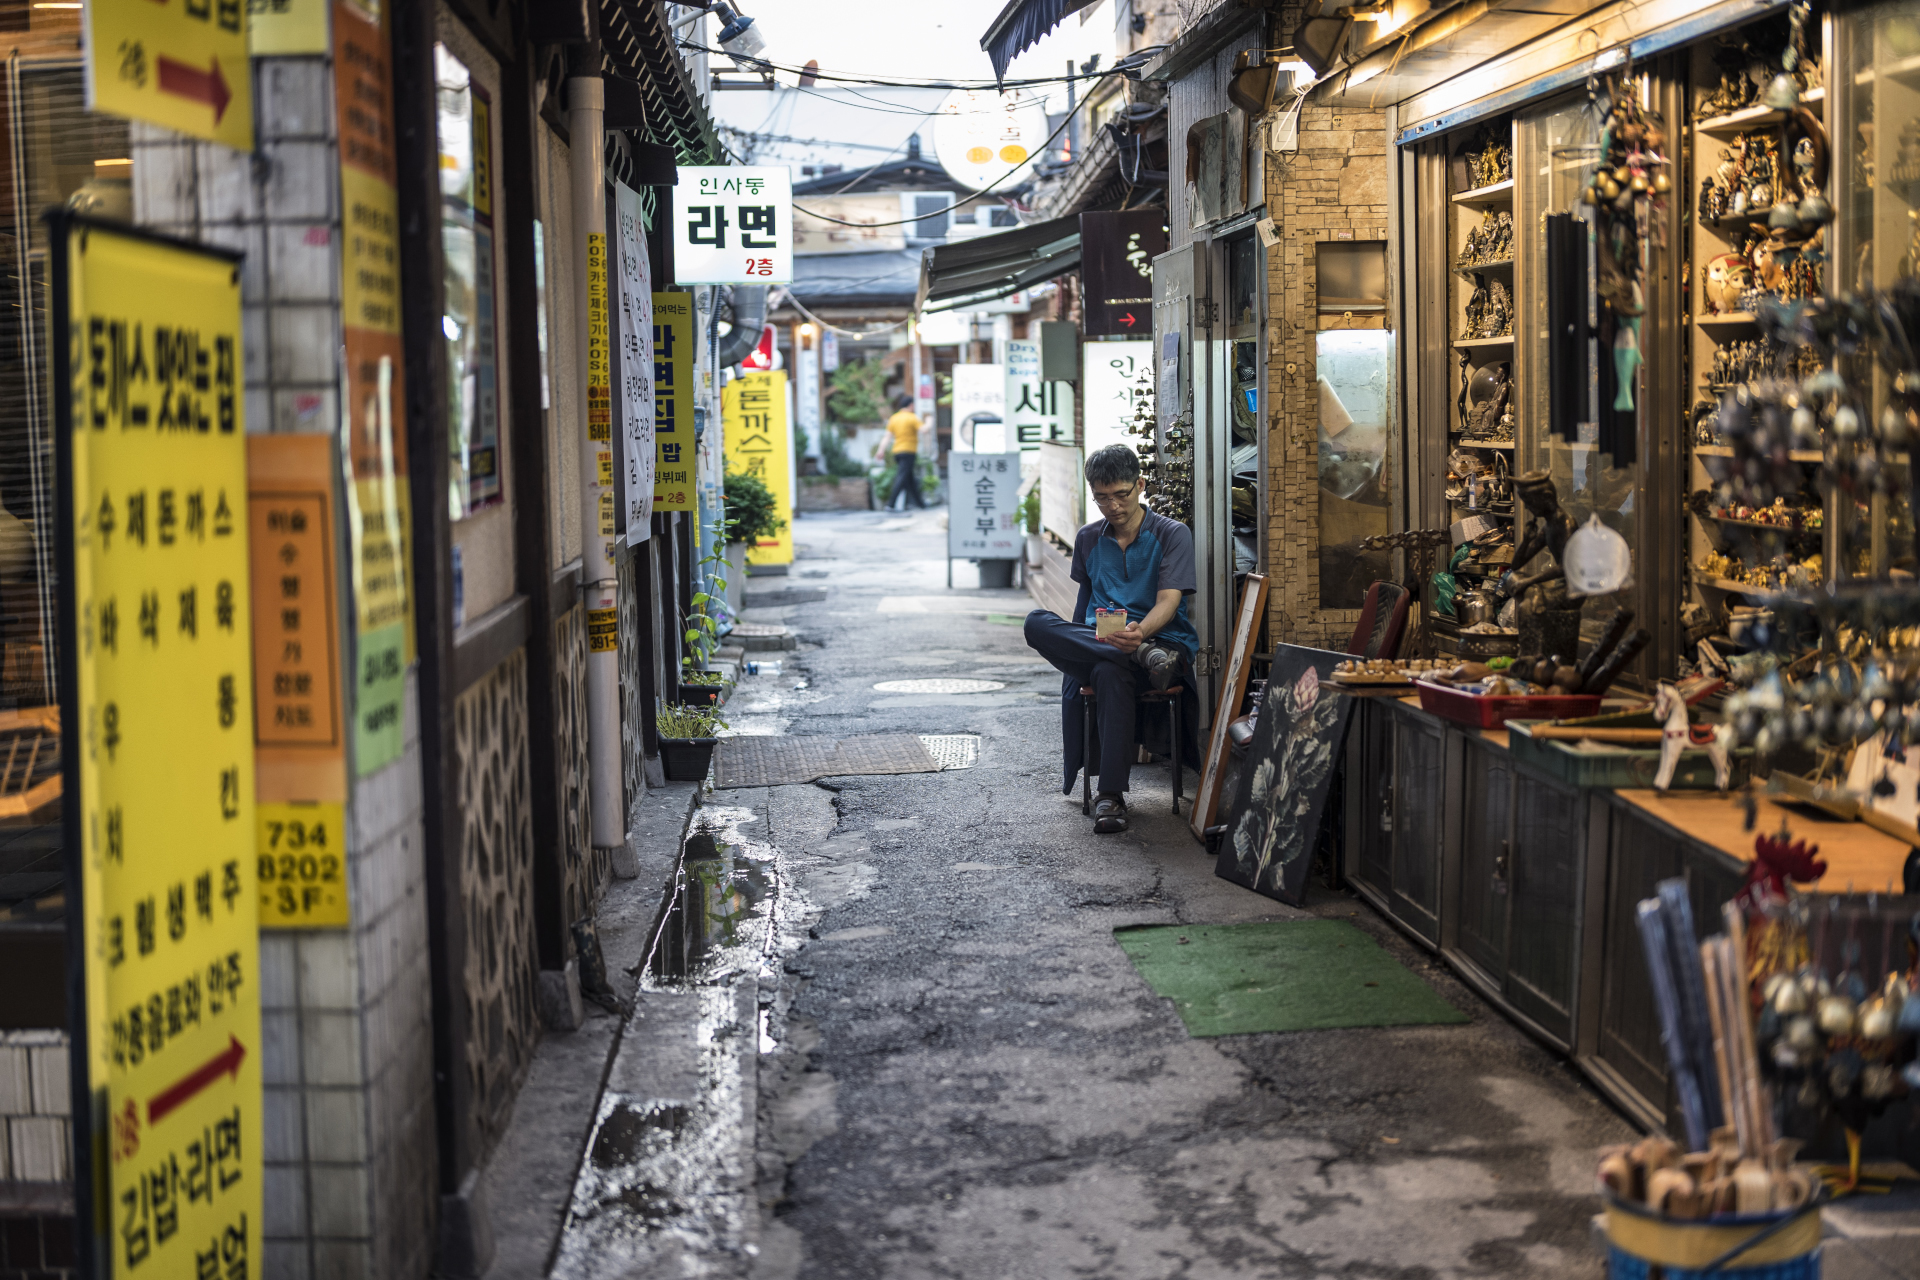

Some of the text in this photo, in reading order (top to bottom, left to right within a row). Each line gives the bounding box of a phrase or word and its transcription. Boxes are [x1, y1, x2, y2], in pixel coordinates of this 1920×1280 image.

[700, 177, 765, 195] 인사동
[687, 205, 777, 249] 라면
[746, 257, 773, 276] 2층
[1009, 355, 1037, 364] Clea
[1009, 367, 1037, 376] Repa
[1110, 355, 1139, 437] 인사동
[738, 390, 773, 453] 돈까스
[962, 459, 1008, 472] 인사동
[668, 492, 686, 504] 2층
[975, 475, 996, 536] 순두부
[96, 486, 233, 551] 수제돈까스
[266, 820, 326, 848] 734
[259, 855, 339, 883] 8202
